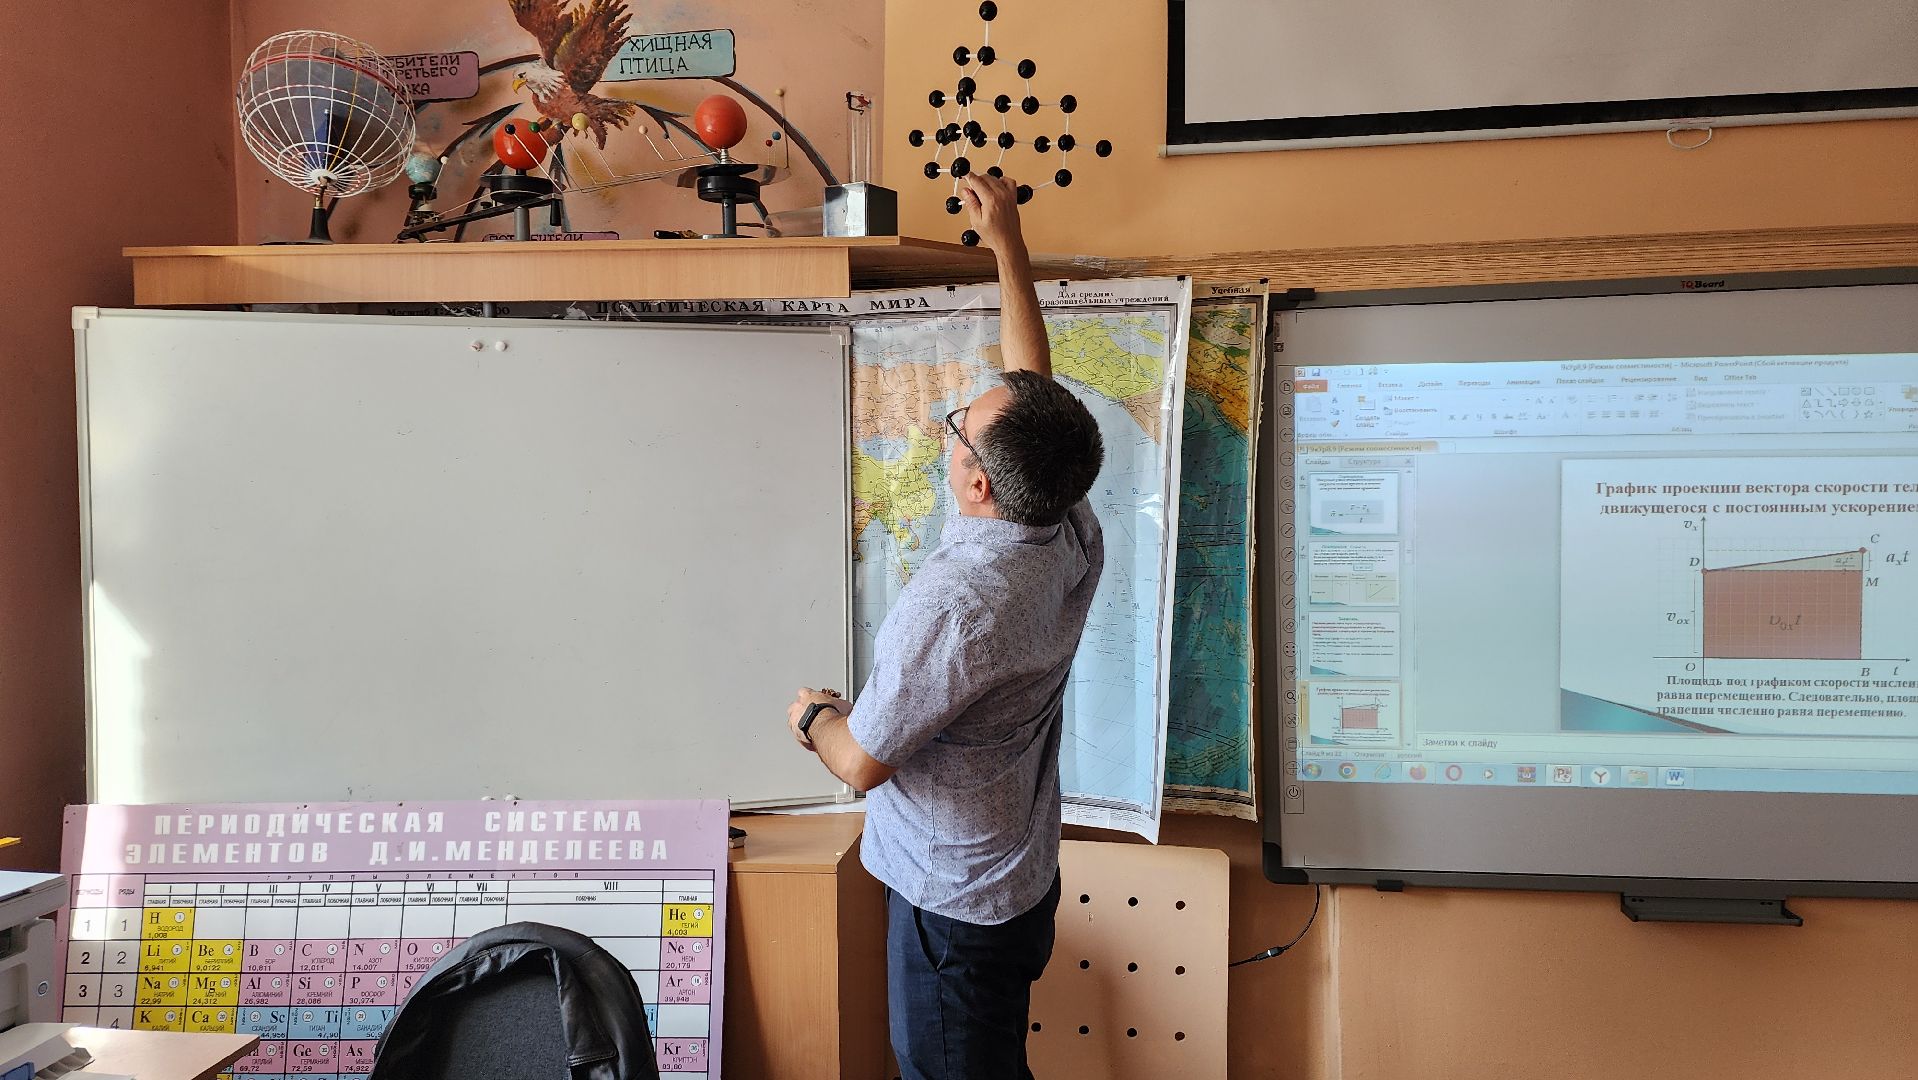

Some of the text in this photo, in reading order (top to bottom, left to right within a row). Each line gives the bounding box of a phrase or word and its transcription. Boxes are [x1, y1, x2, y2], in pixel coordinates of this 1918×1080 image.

[629, 33, 713, 52] ХИЩНАЯ
[620, 57, 690, 75] ПТИЦА
[1058, 291, 1114, 300] Для средних
[1211, 286, 1250, 296] Учебная
[595, 297, 931, 314] ПОЛИТИЧЕСКАЯ КАРТА МИРА
[1039, 296, 1169, 307] бразовательных учреждений
[1595, 482, 1657, 497] График
[1662, 483, 1741, 496] проекции
[1745, 483, 1810, 496] вектора
[1814, 483, 1889, 496] скорости
[1600, 503, 1918, 517] движущегося с постоянным ускорение
[1689, 557, 1700, 567] D
[1667, 675, 1723, 688] Площадь
[1726, 678, 1747, 687] под
[1750, 677, 1811, 689] графиком
[1814, 679, 1869, 689] скорости
[1657, 691, 1693, 702] равна
[1656, 706, 1714, 717] трапеции
[1717, 707, 1775, 716] численно
[1777, 708, 1814, 718] равна
[1422, 738, 1459, 747] Заметки
[1468, 739, 1498, 750] слайду
[154, 810, 643, 838] ПЕРИОДИЧЕСКАЯ СИСТЕМА
[125, 839, 669, 865] ЭЛЕМЕНТОВ Д.И.МЕНДЕЛЕЕВА
[219, 885, 225, 893] II
[268, 885, 279, 893] III
[322, 884, 331, 892] IV
[375, 884, 382, 892] V
[426, 883, 435, 892] VI
[476, 882, 488, 892] VII
[603, 881, 619, 891] VIII
[149, 911, 161, 924] H
[669, 908, 687, 921] He
[84, 919, 91, 932] 1
[121, 918, 128, 932] 1
[157, 925, 184, 933] ВОДОРОД
[146, 944, 161, 957] Li
[197, 943, 215, 957] Be
[248, 943, 259, 957] B
[302, 943, 313, 957] C
[354, 943, 365, 956] N
[407, 942, 418, 955] O
[667, 941, 685, 954] Ne
[80, 951, 91, 965] 2
[117, 950, 127, 965] 2
[144, 964, 164, 972] 6,941
[196, 964, 221, 972] 9,0122
[247, 964, 272, 972] 10,811
[300, 964, 324, 972] 12,011
[405, 963, 430, 971] 15,999
[143, 976, 161, 990] Na
[195, 976, 217, 994] Mg
[246, 976, 262, 990] Al
[298, 976, 311, 990] Si
[351, 976, 361, 989] P
[403, 975, 412, 989] S
[665, 975, 684, 987] Ar
[78, 984, 88, 998] 3
[114, 984, 123, 998] 3
[192, 997, 218, 1005] 24,312
[244, 997, 269, 1005] 26,982
[296, 997, 322, 1005] 28,086
[349, 997, 375, 1005] 30,974
[140, 1010, 152, 1023] K
[192, 1010, 209, 1023] Ca
[269, 1010, 286, 1024] Sc
[324, 1010, 339, 1023] Ti
[381, 1009, 392, 1022] V
[110, 1017, 120, 1030] 4
[293, 1043, 313, 1057] Ge
[346, 1044, 363, 1057] As
[663, 1042, 682, 1055] Kr
[292, 1065, 313, 1073] 72,59
[344, 1065, 370, 1073] 74,922
